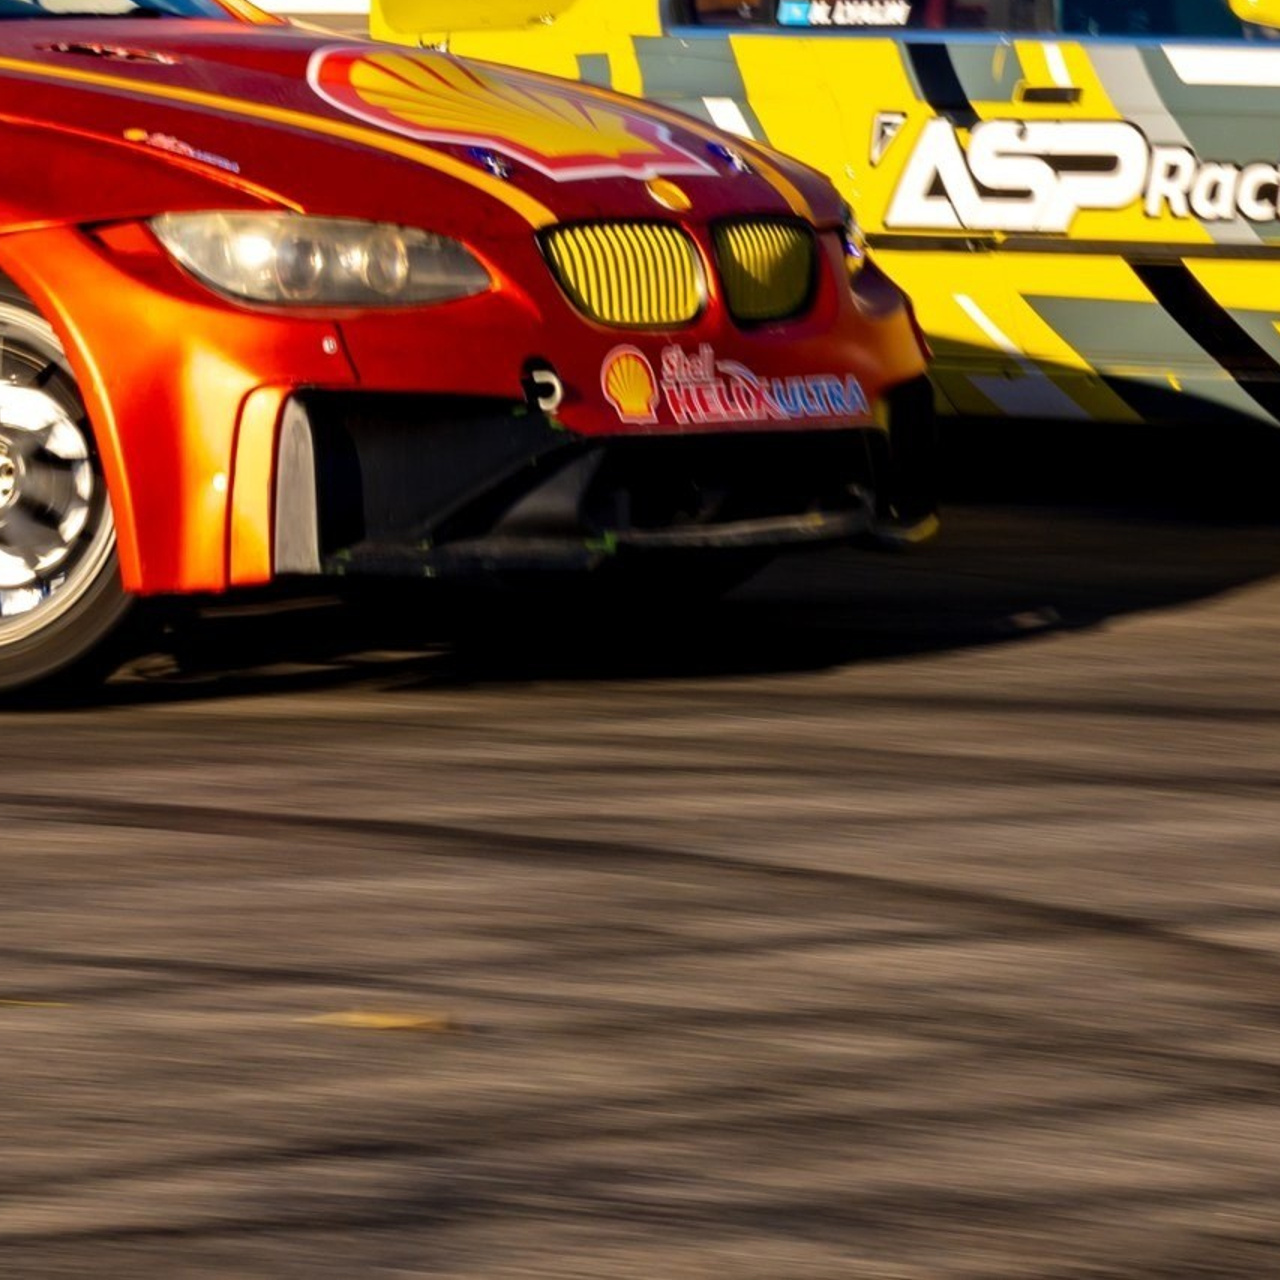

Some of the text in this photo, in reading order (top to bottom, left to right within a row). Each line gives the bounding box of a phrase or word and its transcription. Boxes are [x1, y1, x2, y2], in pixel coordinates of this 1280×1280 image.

[885, 116, 1280, 233] ASP Rac
[661, 342, 716, 384] Shell
[766, 374, 870, 419] ULTRA
